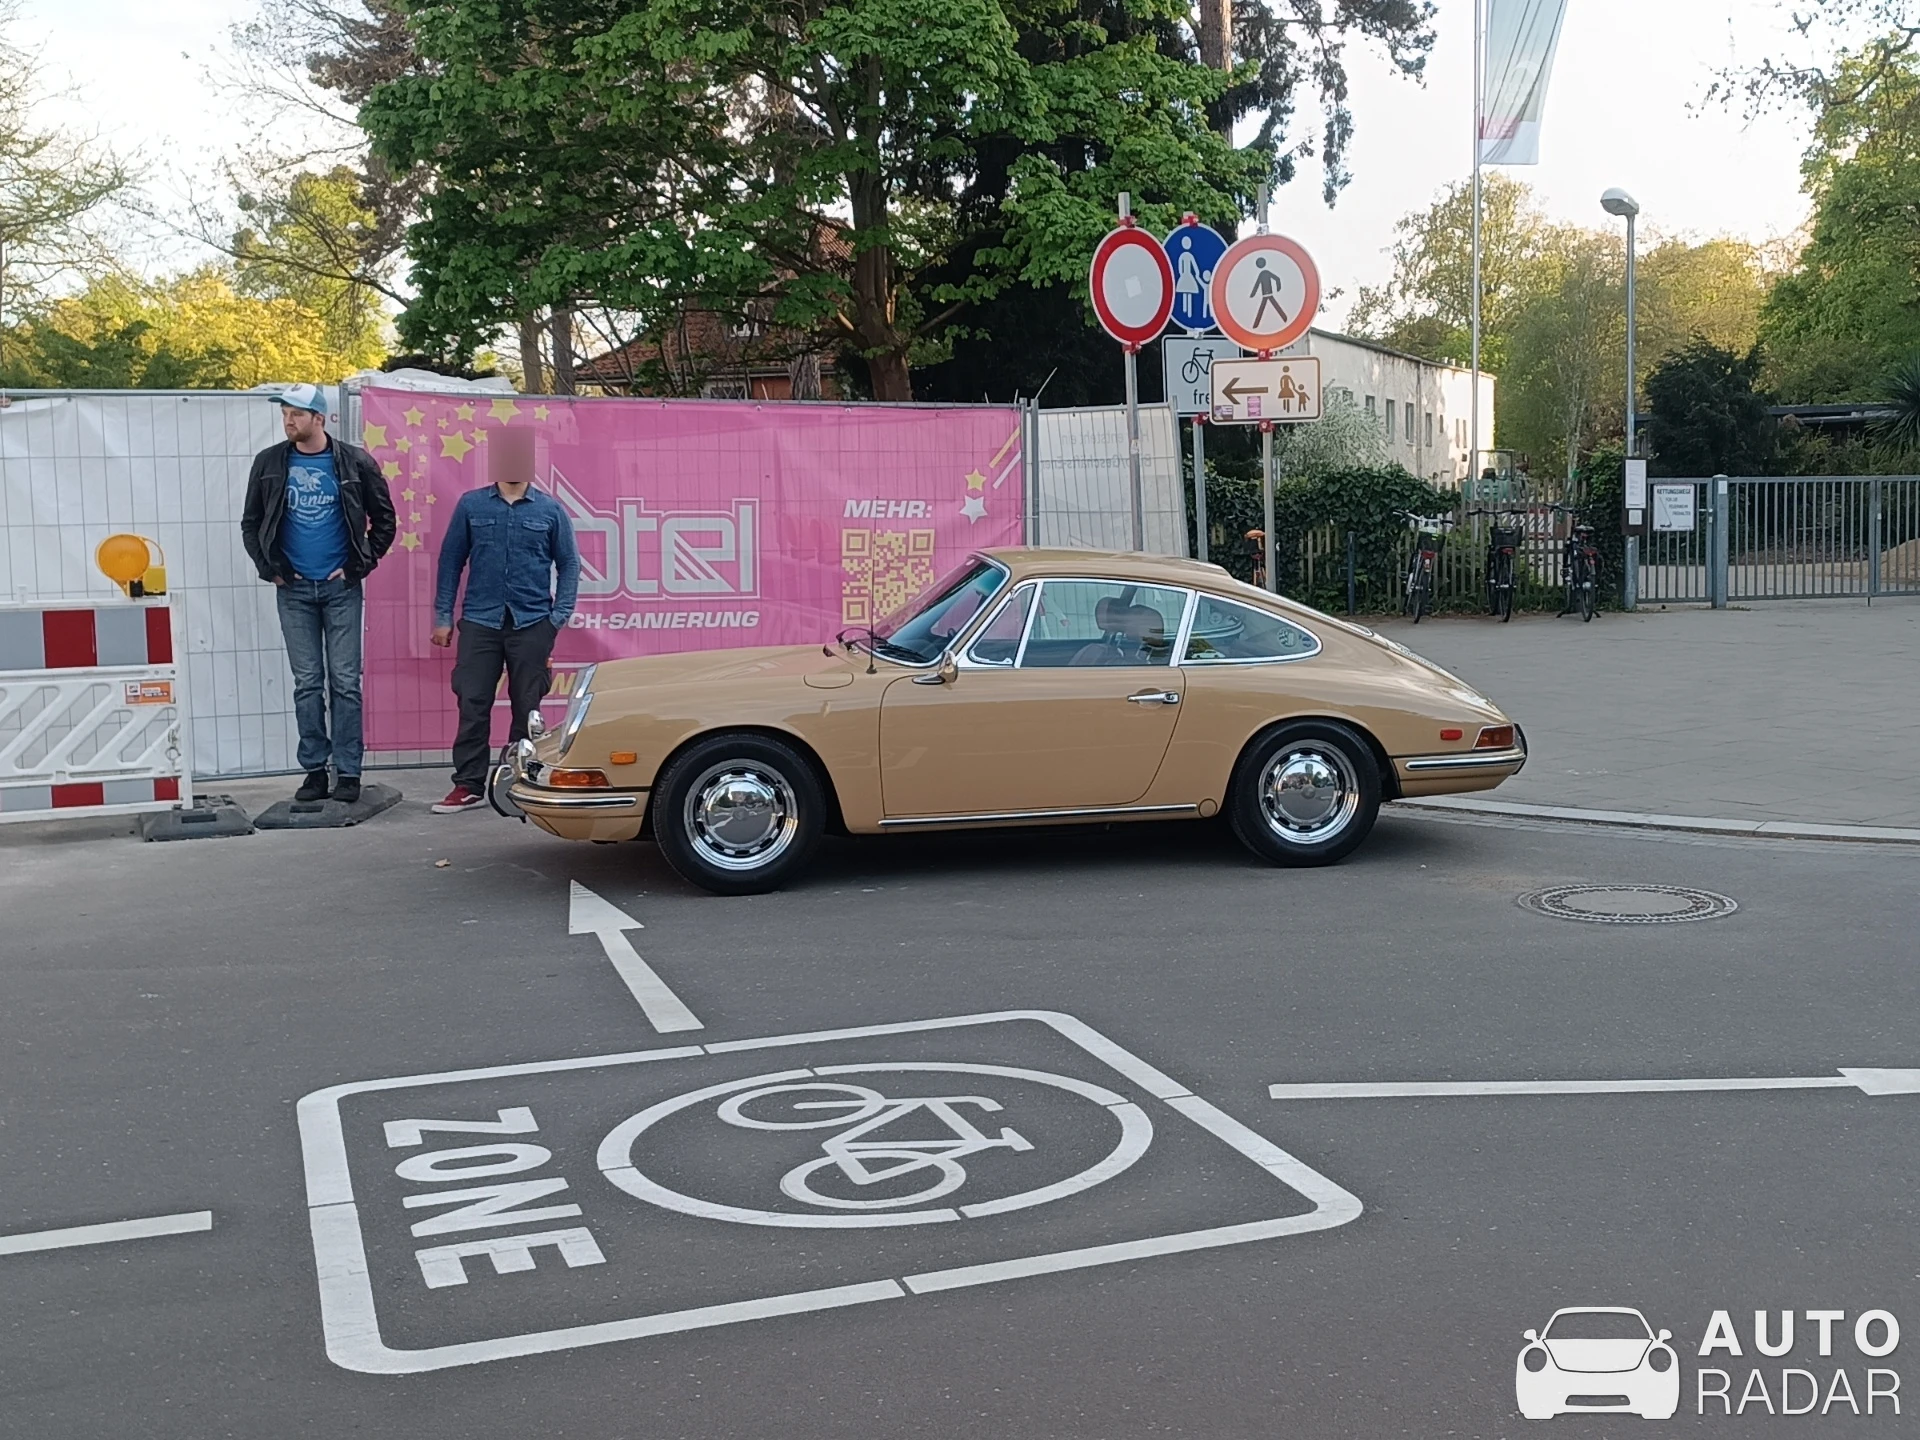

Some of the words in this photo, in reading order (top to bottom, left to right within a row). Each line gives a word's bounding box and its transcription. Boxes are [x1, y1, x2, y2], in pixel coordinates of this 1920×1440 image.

[1193, 388, 1210, 405] fre
[285, 485, 334, 510] Denim
[843, 499, 933, 518] MEHR:
[550, 474, 757, 598] otel
[568, 611, 759, 629] CH-SANIERUNG
[383, 1106, 607, 1289] ZONE
